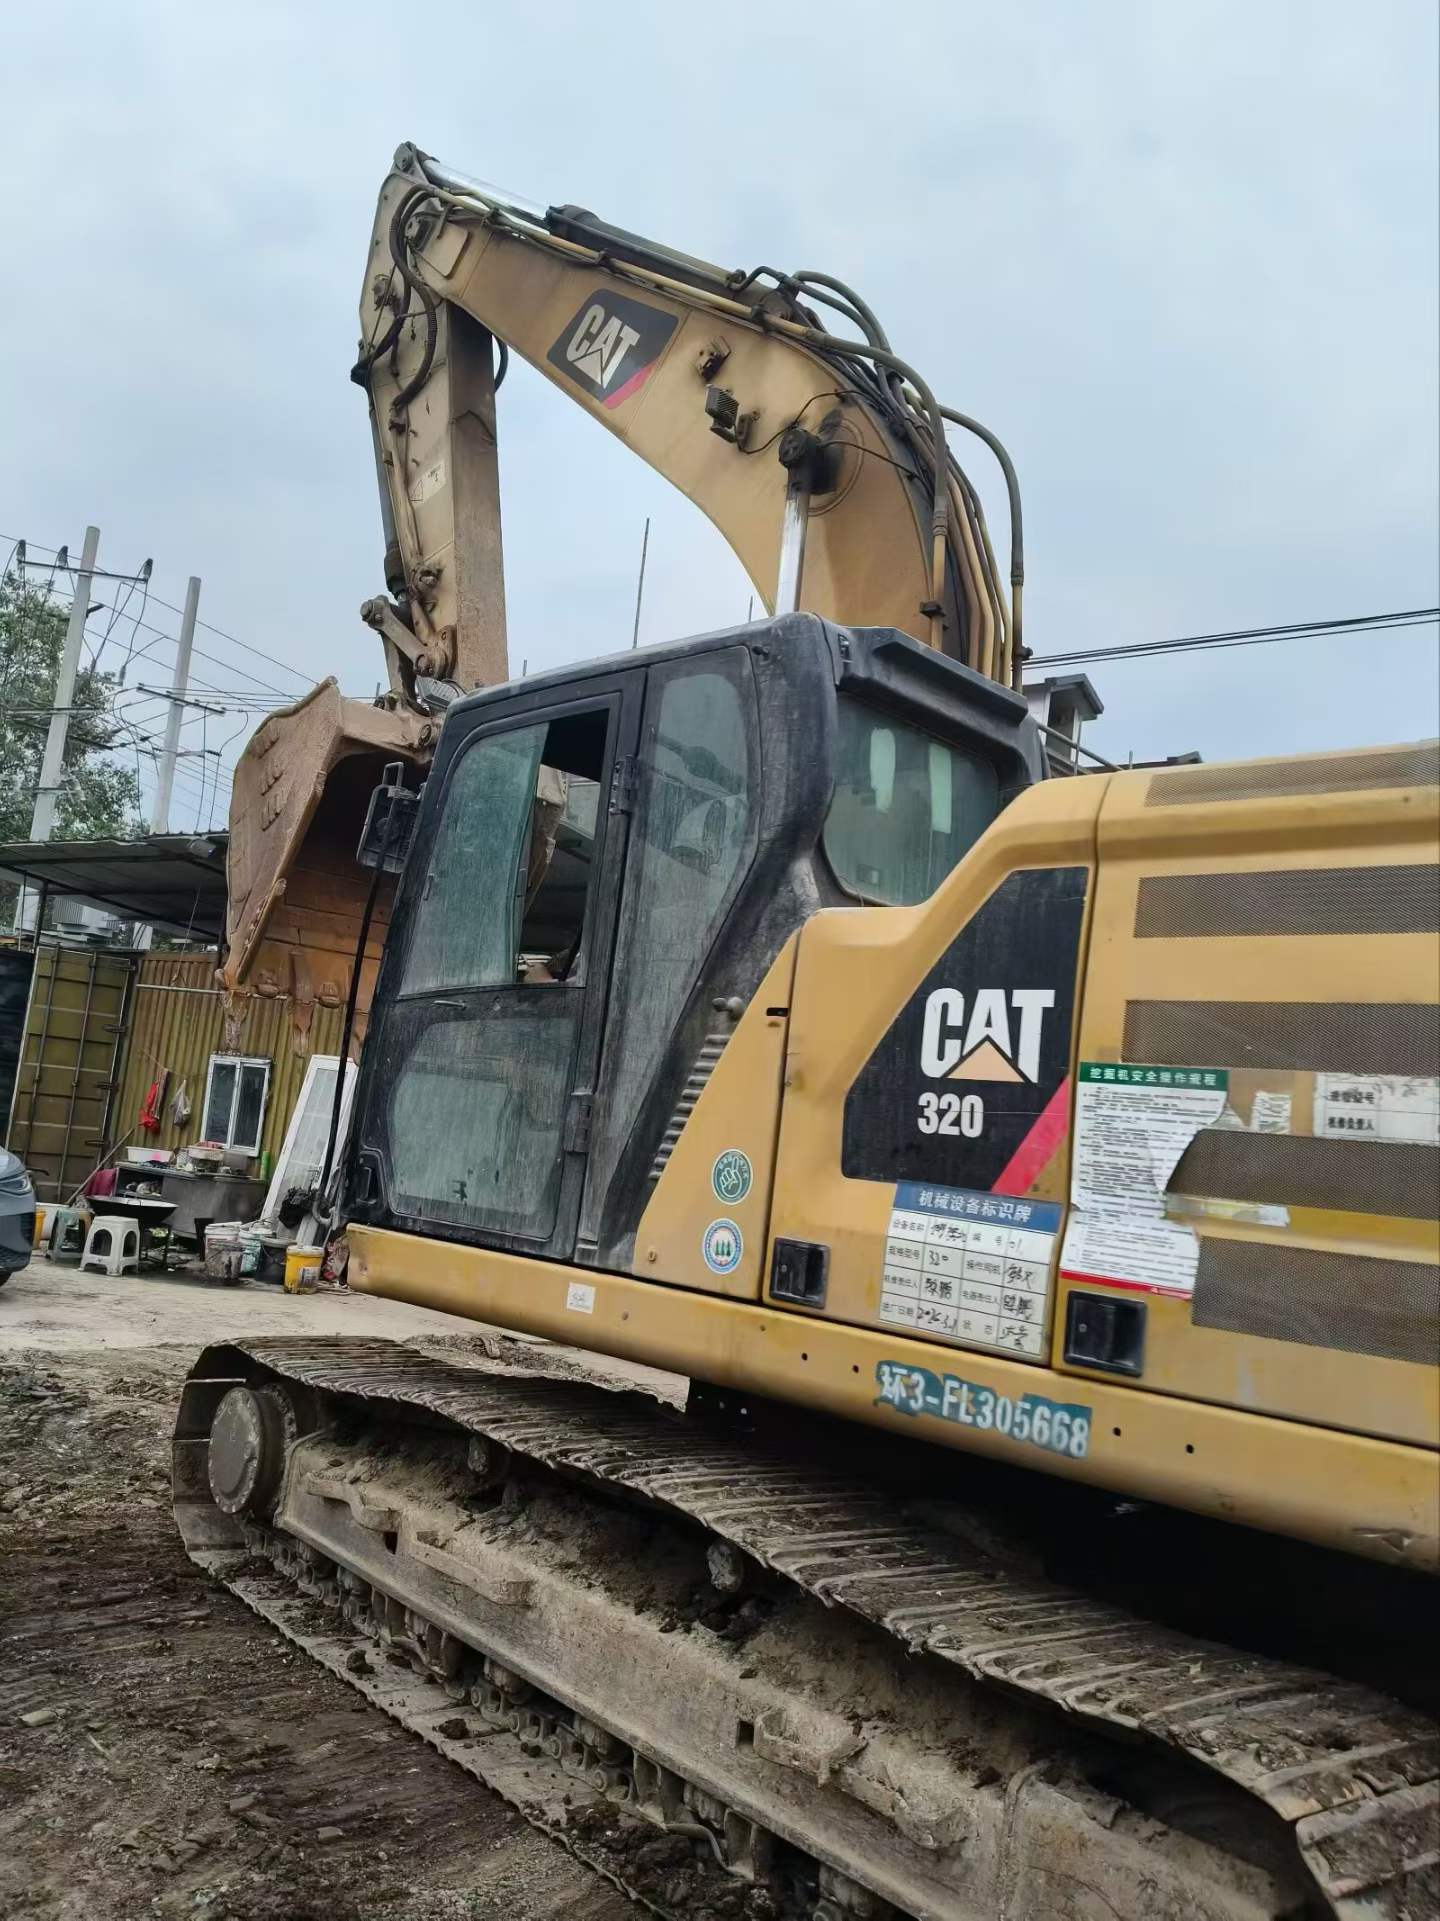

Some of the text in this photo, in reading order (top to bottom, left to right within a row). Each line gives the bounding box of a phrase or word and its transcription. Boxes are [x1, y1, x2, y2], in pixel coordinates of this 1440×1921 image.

[566, 304, 640, 389] CAT
[921, 988, 1055, 1083] CAT
[1090, 1067, 1217, 1086] 挖掘机安全操作规程
[917, 1092, 984, 1138] 320
[918, 1190, 1032, 1223] 机械设备标识牌
[879, 1365, 1089, 1458] 环3-FL305668
